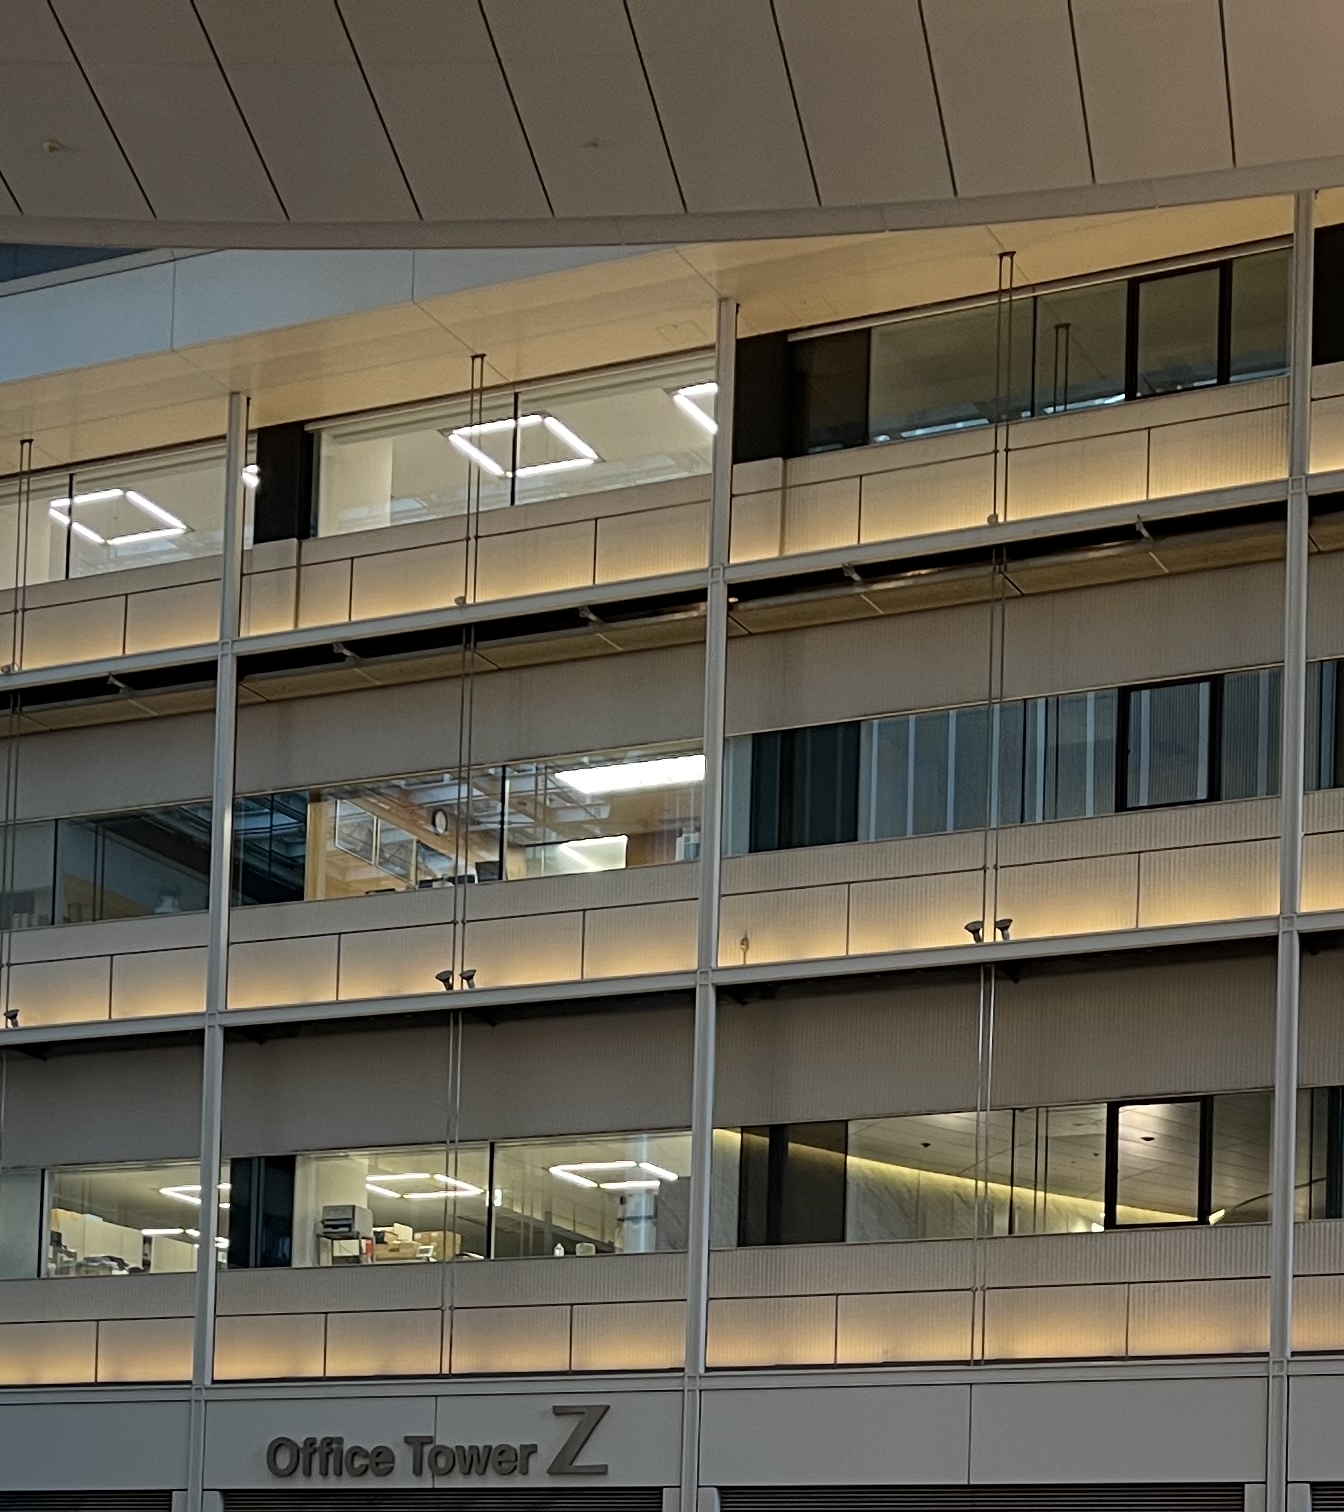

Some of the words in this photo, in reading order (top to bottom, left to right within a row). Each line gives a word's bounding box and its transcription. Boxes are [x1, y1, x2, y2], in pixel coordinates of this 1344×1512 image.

[266, 1436, 396, 1478] Office
[403, 1435, 539, 1477] Tower
[546, 1404, 611, 1475] Z
